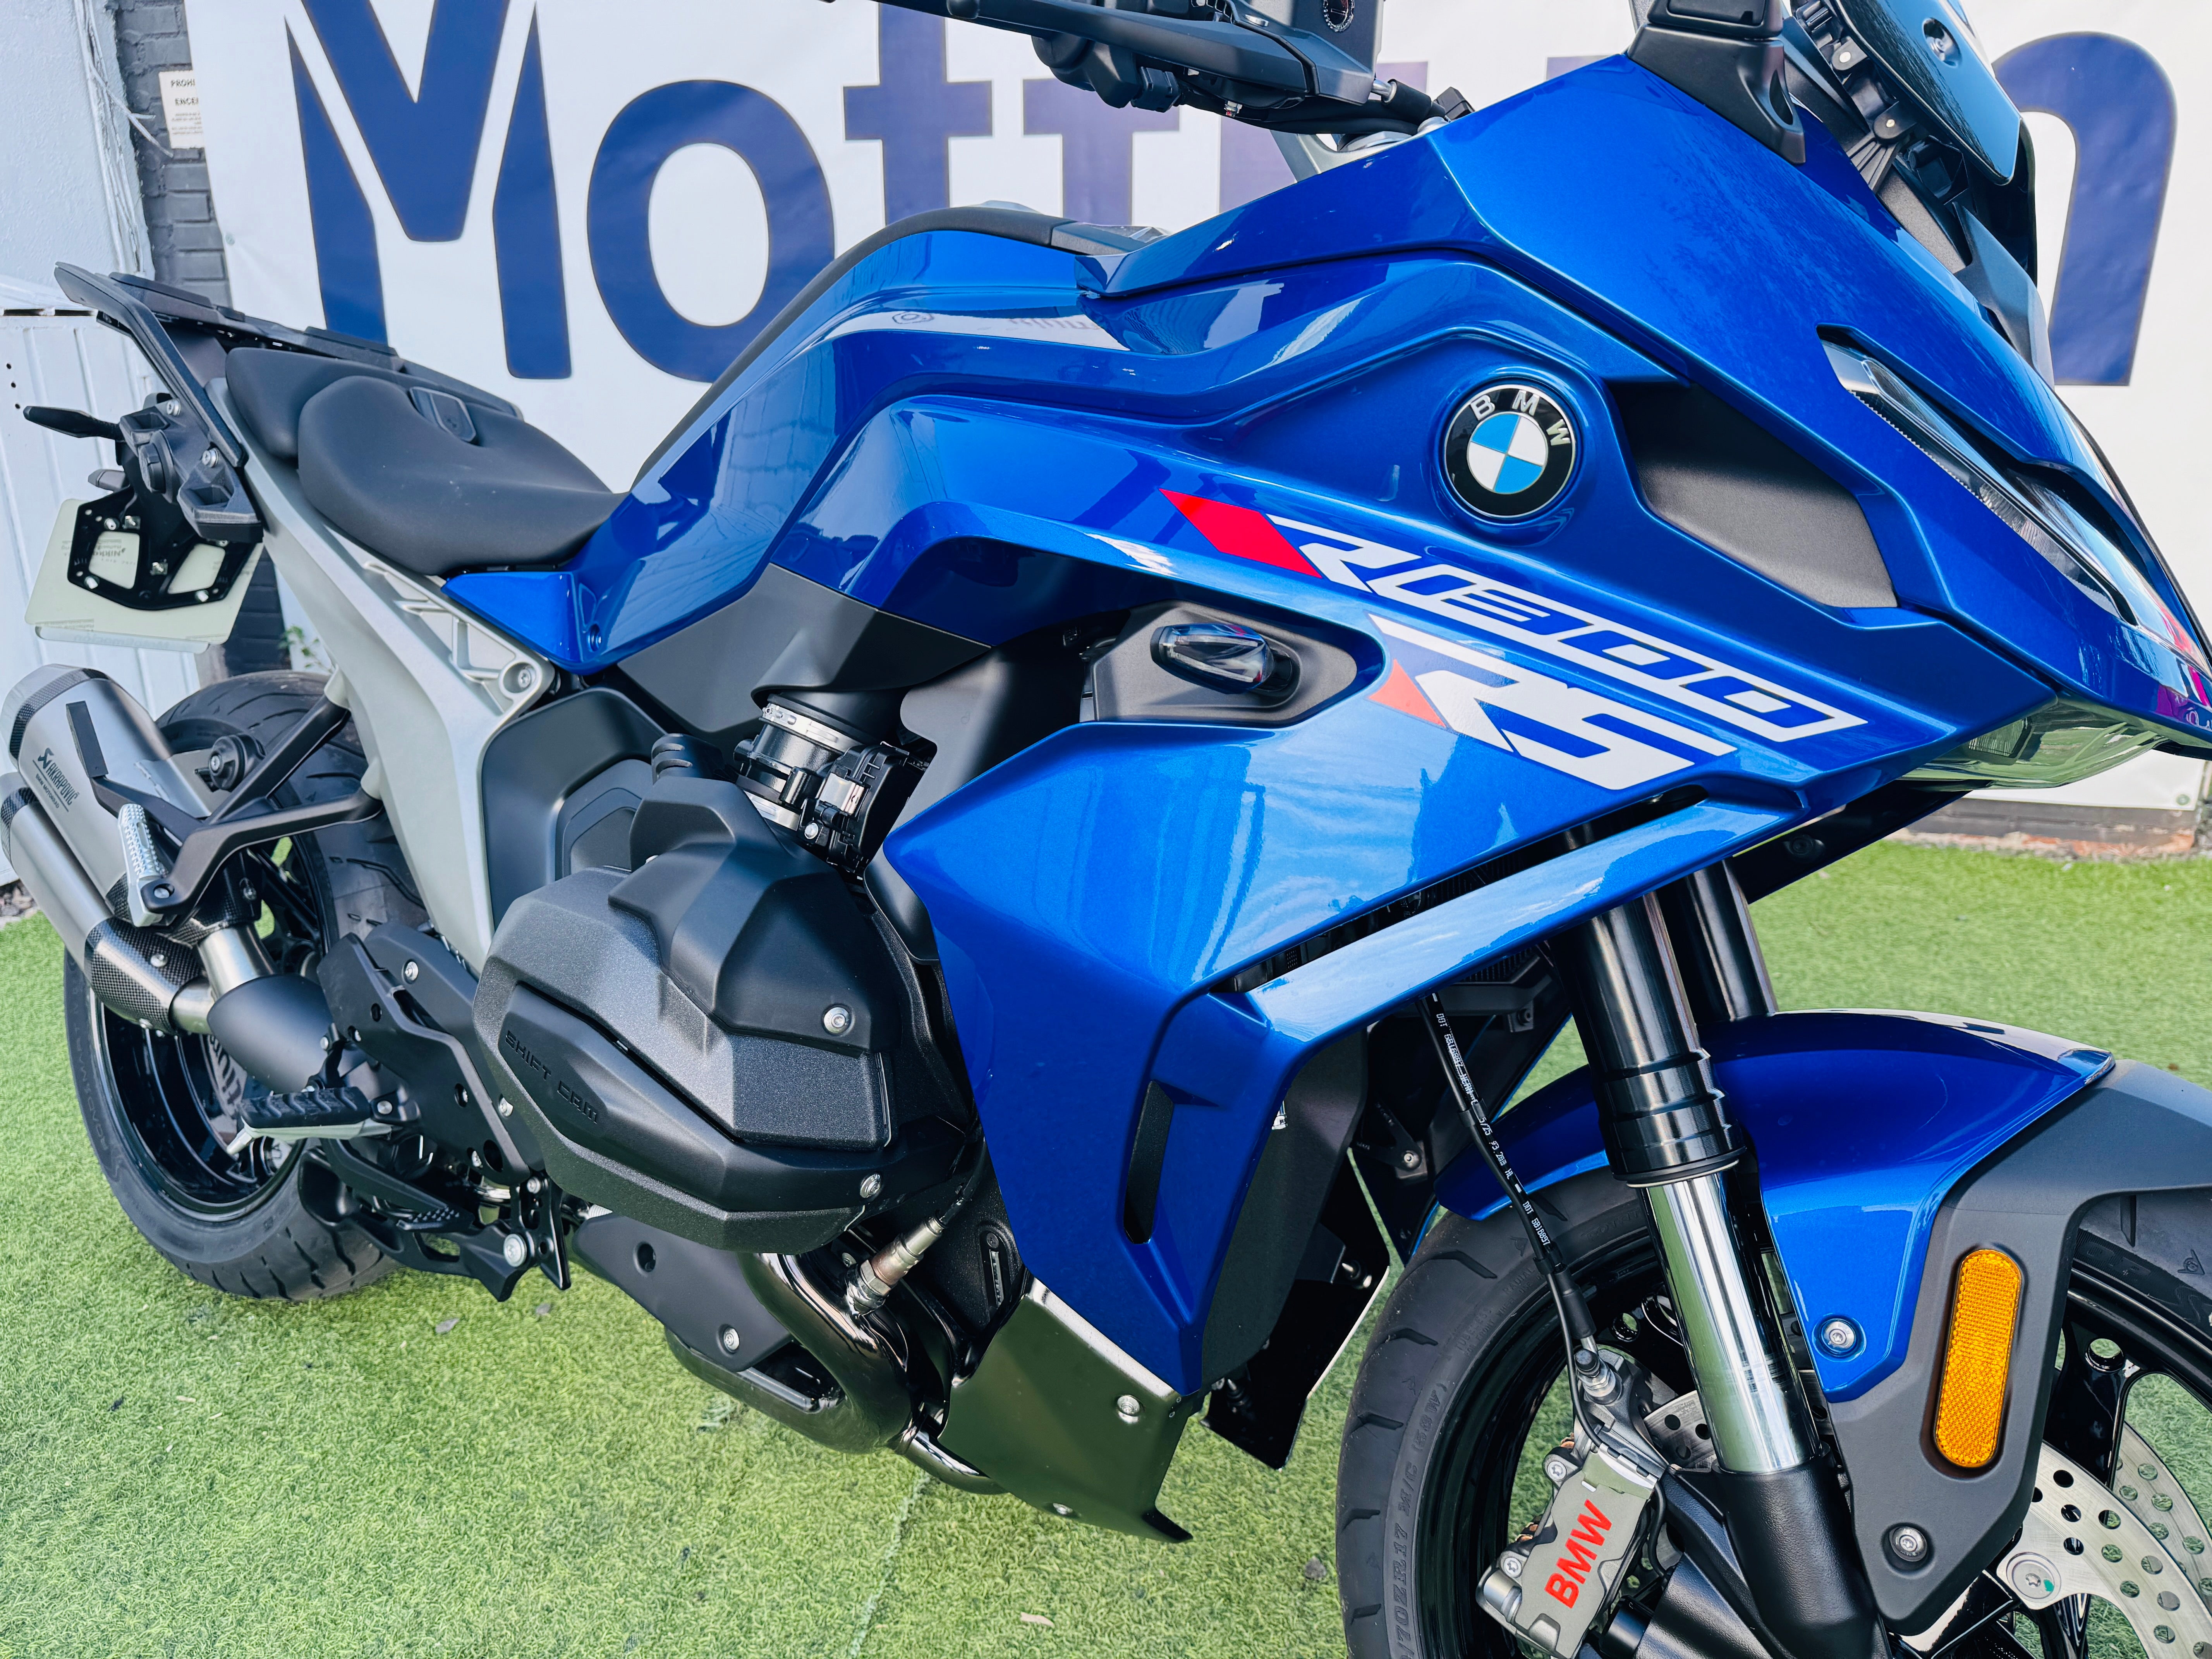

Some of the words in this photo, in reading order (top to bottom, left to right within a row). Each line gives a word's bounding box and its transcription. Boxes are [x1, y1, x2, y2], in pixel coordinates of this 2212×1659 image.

[1470, 390, 1571, 446] BMW
[43, 784, 59, 809] MOTORRAD
[1436, 1013, 1448, 1027] DOT
[505, 1030, 551, 1081] SHIFT
[557, 1080, 598, 1124] CAM
[1523, 1201, 1534, 1214] DOT
[1544, 1499, 1612, 1609] BMW
[1394, 1523, 1415, 1659] /70ZR17
